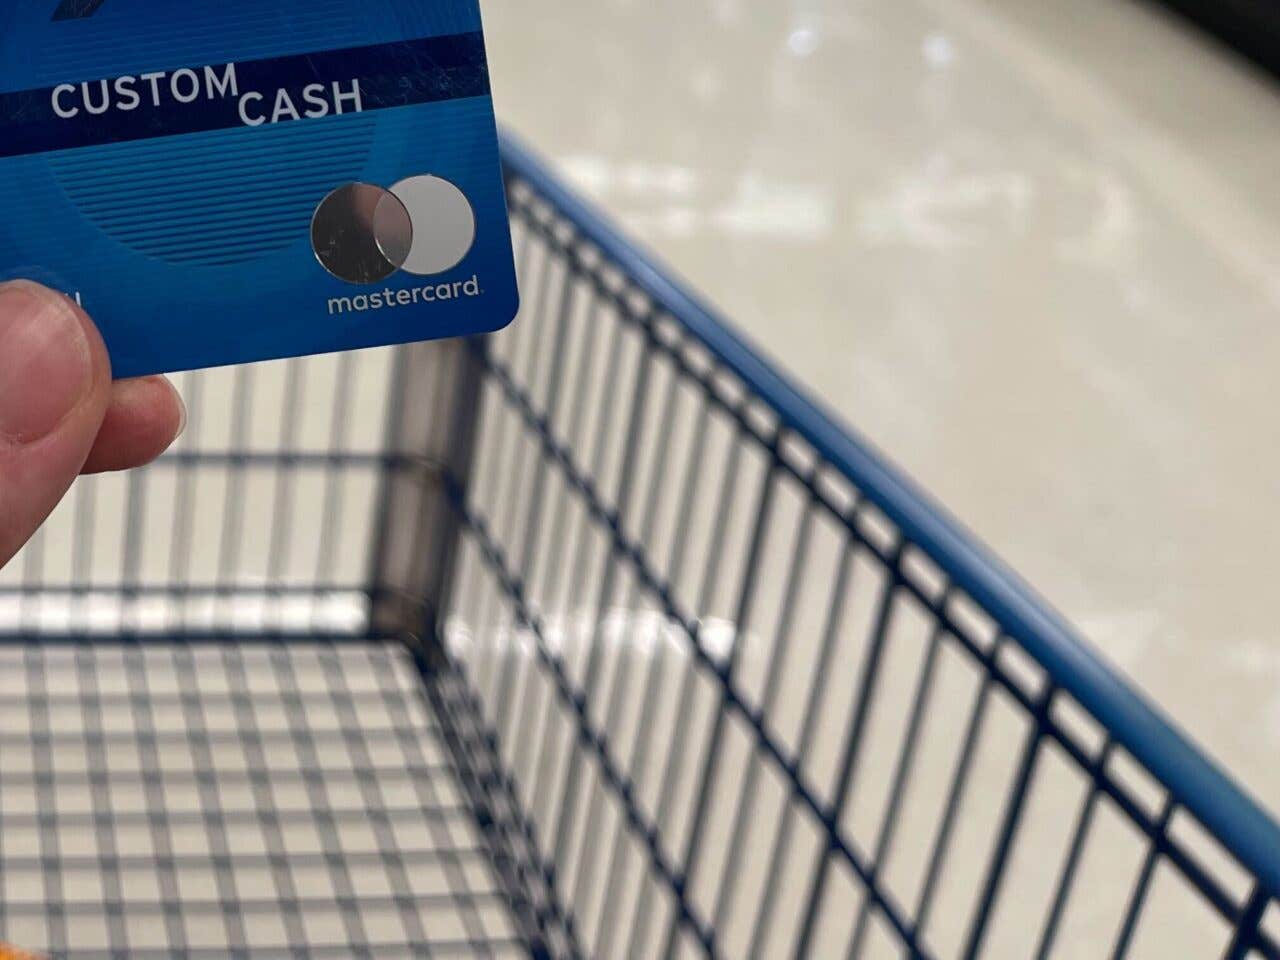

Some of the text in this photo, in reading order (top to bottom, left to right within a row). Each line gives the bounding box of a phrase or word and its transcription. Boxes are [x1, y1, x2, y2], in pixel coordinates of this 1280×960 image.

[51, 62, 364, 127] CUSTOM CASH
[327, 274, 480, 315] mastercard
